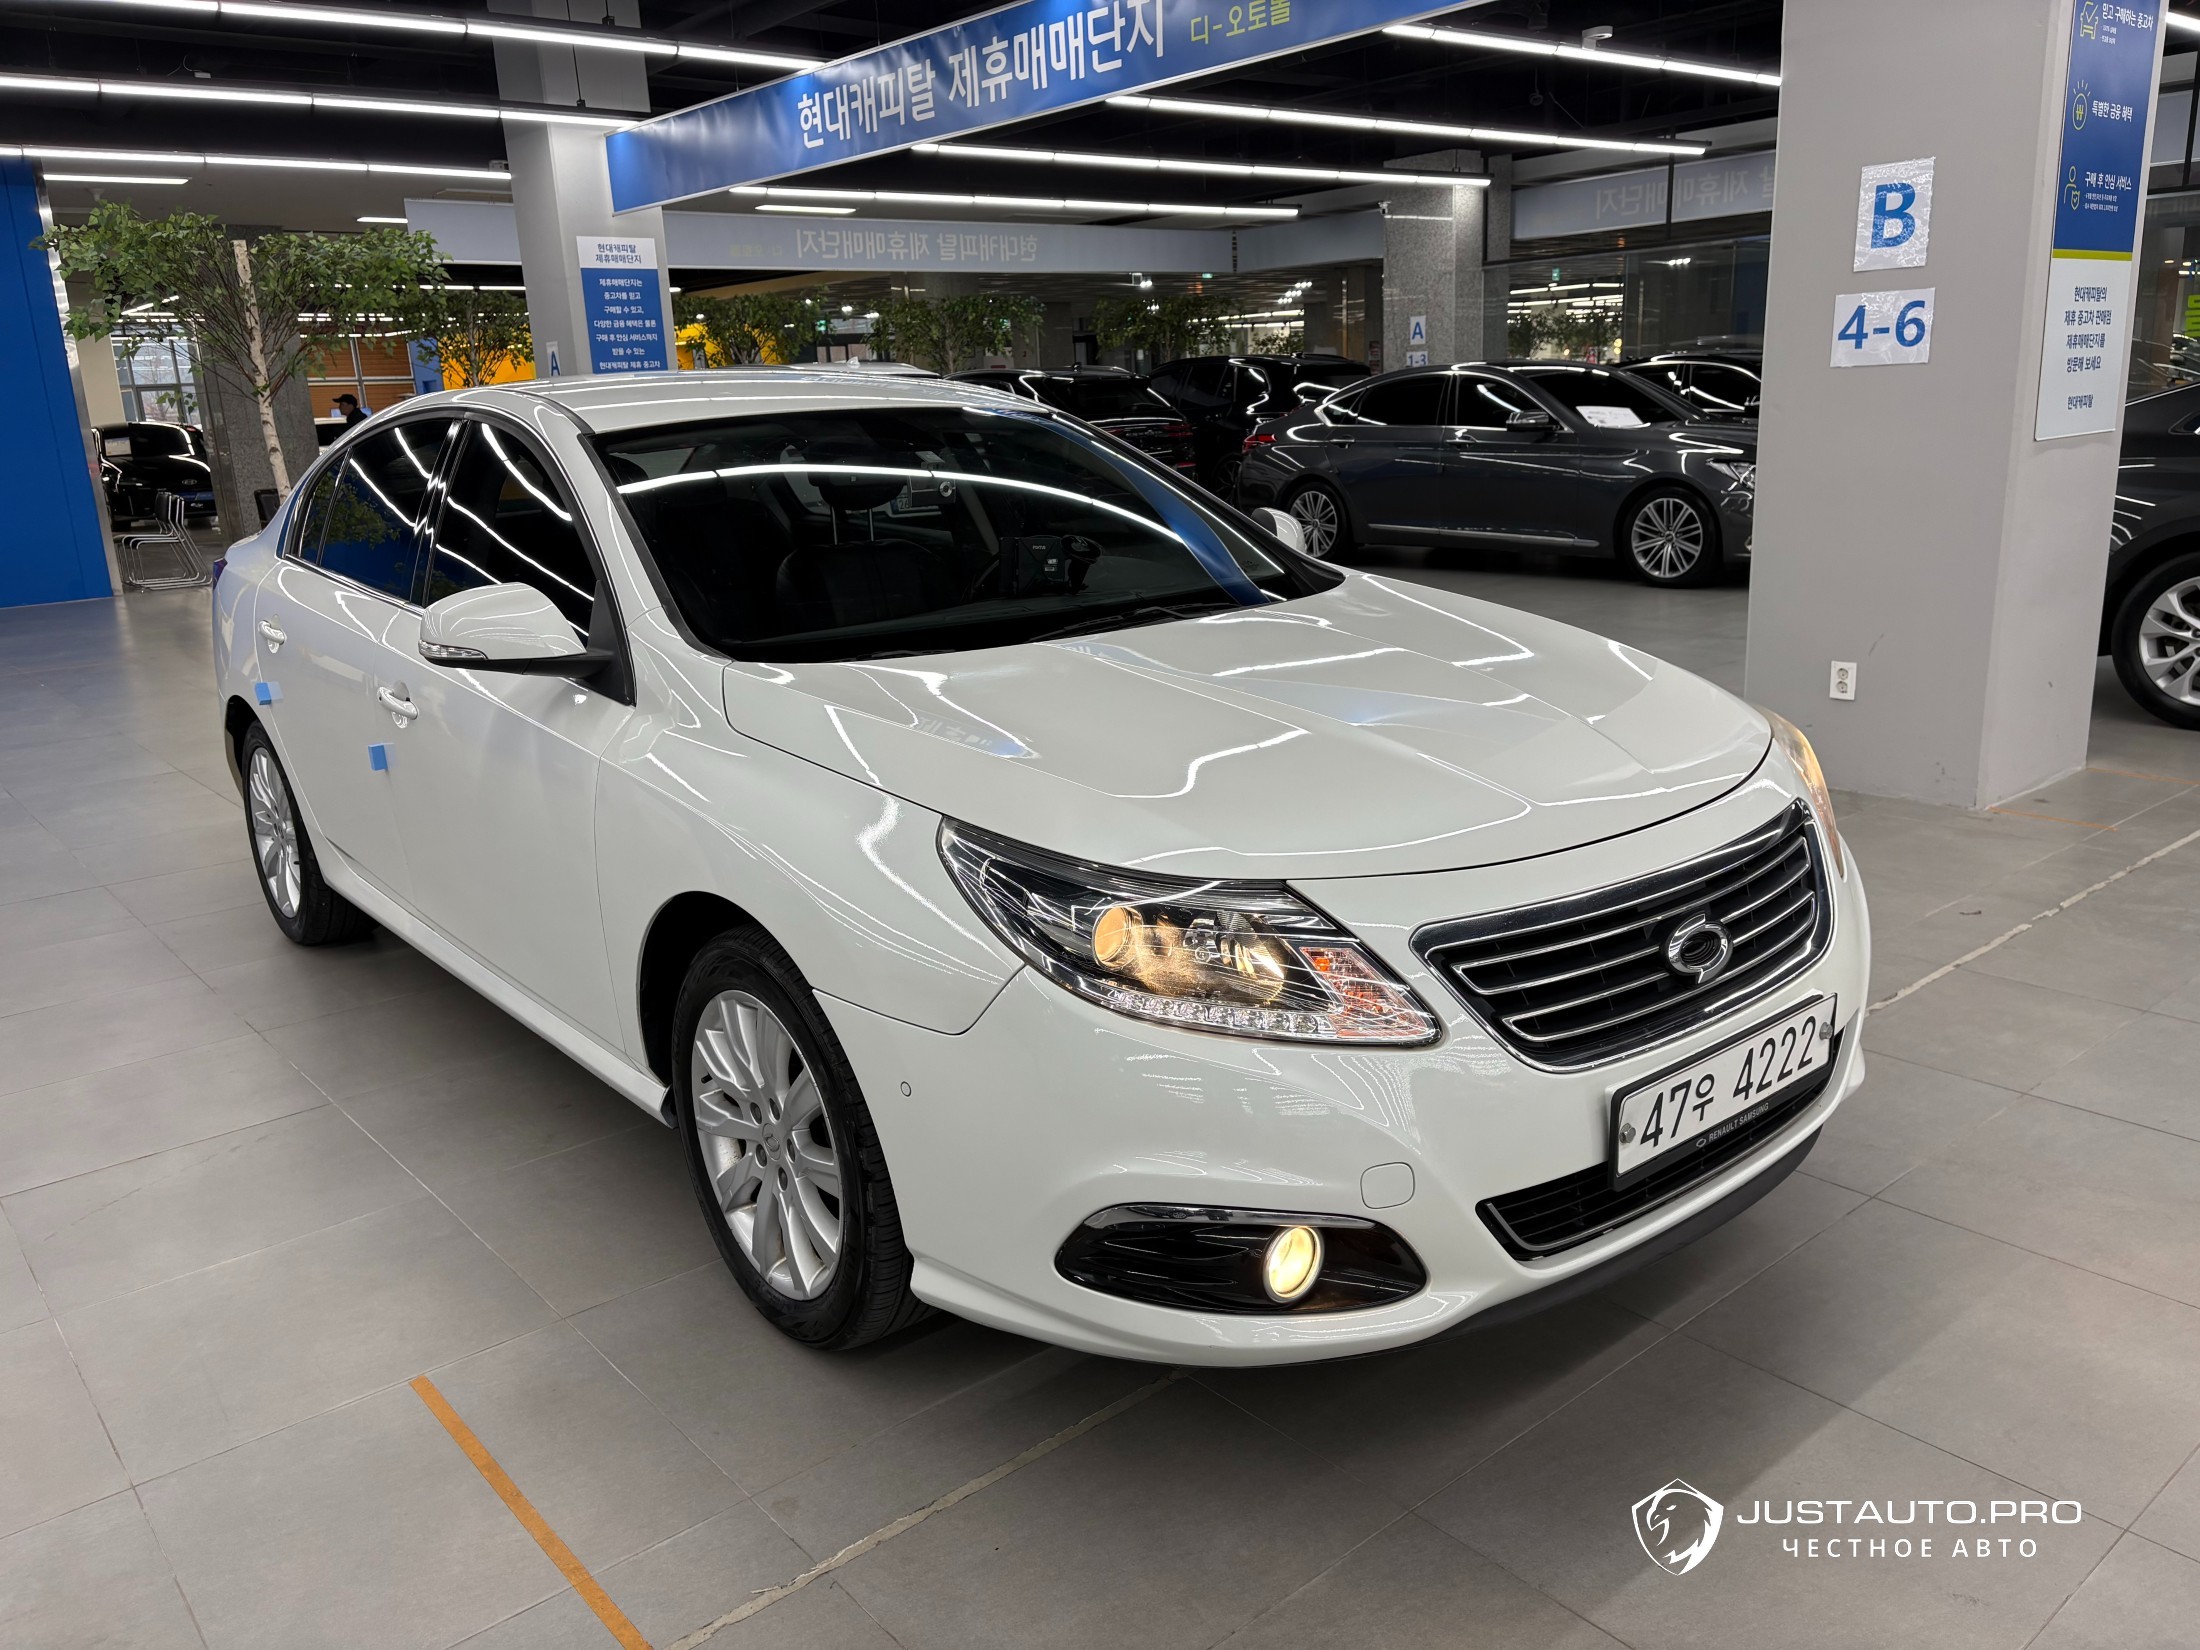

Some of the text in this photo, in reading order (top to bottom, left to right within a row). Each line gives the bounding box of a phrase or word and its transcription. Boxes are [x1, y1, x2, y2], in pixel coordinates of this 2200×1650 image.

[2102, 3, 2114, 20] 믿고
[2115, 6, 2137, 27] 구매하는
[2137, 12, 2154, 31] 중고차
[798, 59, 936, 149] 현대캐피탈
[948, 0, 1164, 108] 제휴매매단지
[2092, 100, 2133, 122] 특별한 금융 혜택
[2085, 171, 2132, 191] 구매 후 안심 서비스
[1871, 182, 1916, 249] B
[597, 243, 636, 253] 현대캐피탈
[595, 253, 642, 264] 제휴매매단지
[599, 278, 643, 287] 제휴매매단지는
[2074, 286, 2107, 302] 현대캐피탈의
[623, 305, 630, 314] 수
[2064, 309, 2112, 326] 제휴 중고차 판매점
[1412, 322, 1424, 340] A
[1838, 300, 1926, 349] 4-6
[2066, 333, 2106, 349] 제휴매매단지를
[551, 351, 560, 376] A
[1408, 354, 1427, 367] 1-3
[2067, 356, 2102, 373] 방문해 보세요
[2067, 394, 2094, 410] 현대캐피탈
[1640, 1015, 1816, 1148] 47우 4222
[1708, 1102, 1769, 1143] RENAULT SAMSUNG
